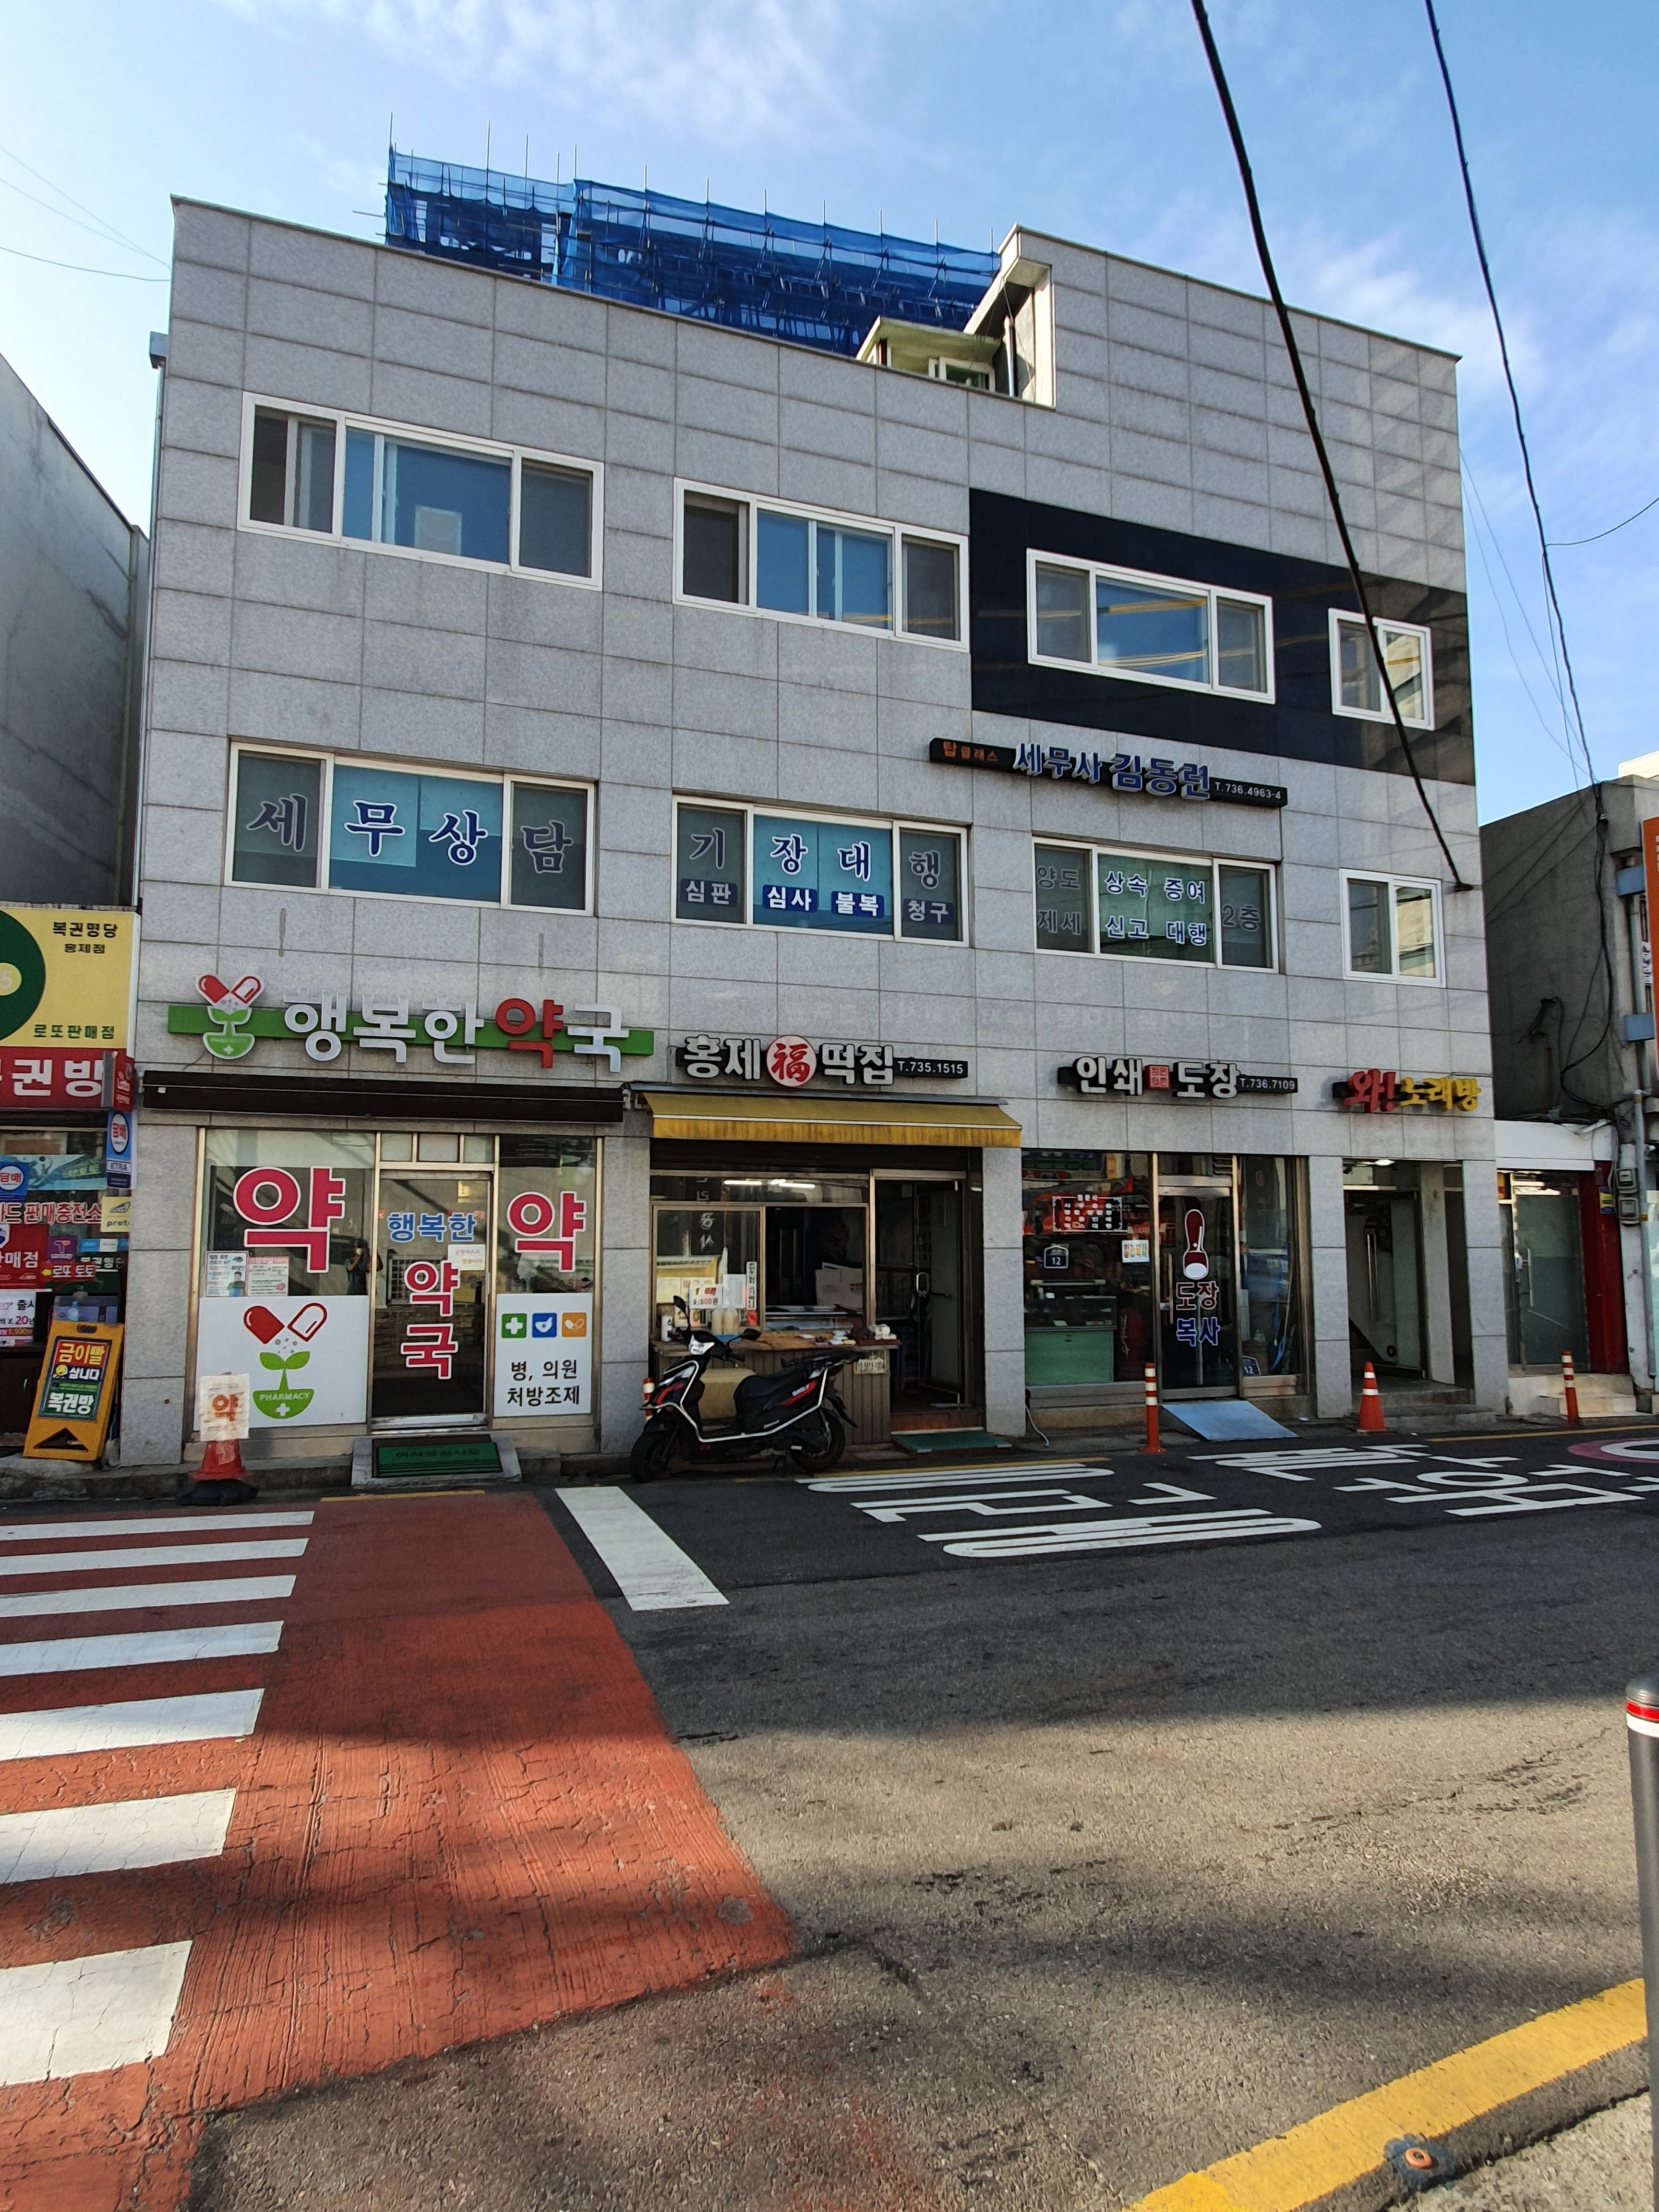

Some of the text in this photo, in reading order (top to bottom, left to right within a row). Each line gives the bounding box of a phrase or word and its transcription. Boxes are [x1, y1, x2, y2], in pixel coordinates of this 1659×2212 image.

[1013, 742, 1100, 784] 세무사
[1110, 752, 1210, 801] 김동련
[246, 793, 573, 874] 세무상담
[689, 827, 941, 889] 기장대행
[1036, 866, 1205, 904] 양도 상속 증여
[685, 880, 950, 924] 심판 심사 불복 청구
[52, 922, 118, 938] 복권명당
[1037, 910, 1207, 946] 제세 신고 대행
[1221, 905, 1261, 932] 2층
[34, 1024, 115, 1039] 로또판매점
[684, 1034, 964, 1085] 홍제 福 떡집 T.735.1515
[0, 1059, 103, 1098] 권방
[1076, 1057, 1143, 1095] 인쇄
[1177, 1062, 1240, 1099] 도장
[1240, 1078, 1296, 1090] T.736.7109
[1400, 1077, 1481, 1112] 노래방
[24, 1201, 102, 1225] 판매충전소
[233, 1166, 346, 1274] 약
[387, 1212, 477, 1242] 행복한
[507, 1191, 587, 1273] 약
[1051, 1257, 1061, 1265] 12
[1176, 1281, 1219, 1310] 도장
[1177, 1317, 1221, 1347] 복사
[59, 1343, 105, 1366] 금이빨
[541, 1359, 578, 1380] 의원
[68, 1367, 100, 1381] 삽니다
[48, 1392, 94, 1415] 복권방
[212, 1395, 238, 1422] 약
[260, 1391, 311, 1401] PHARMACY
[507, 1385, 580, 1407] 처방조제
